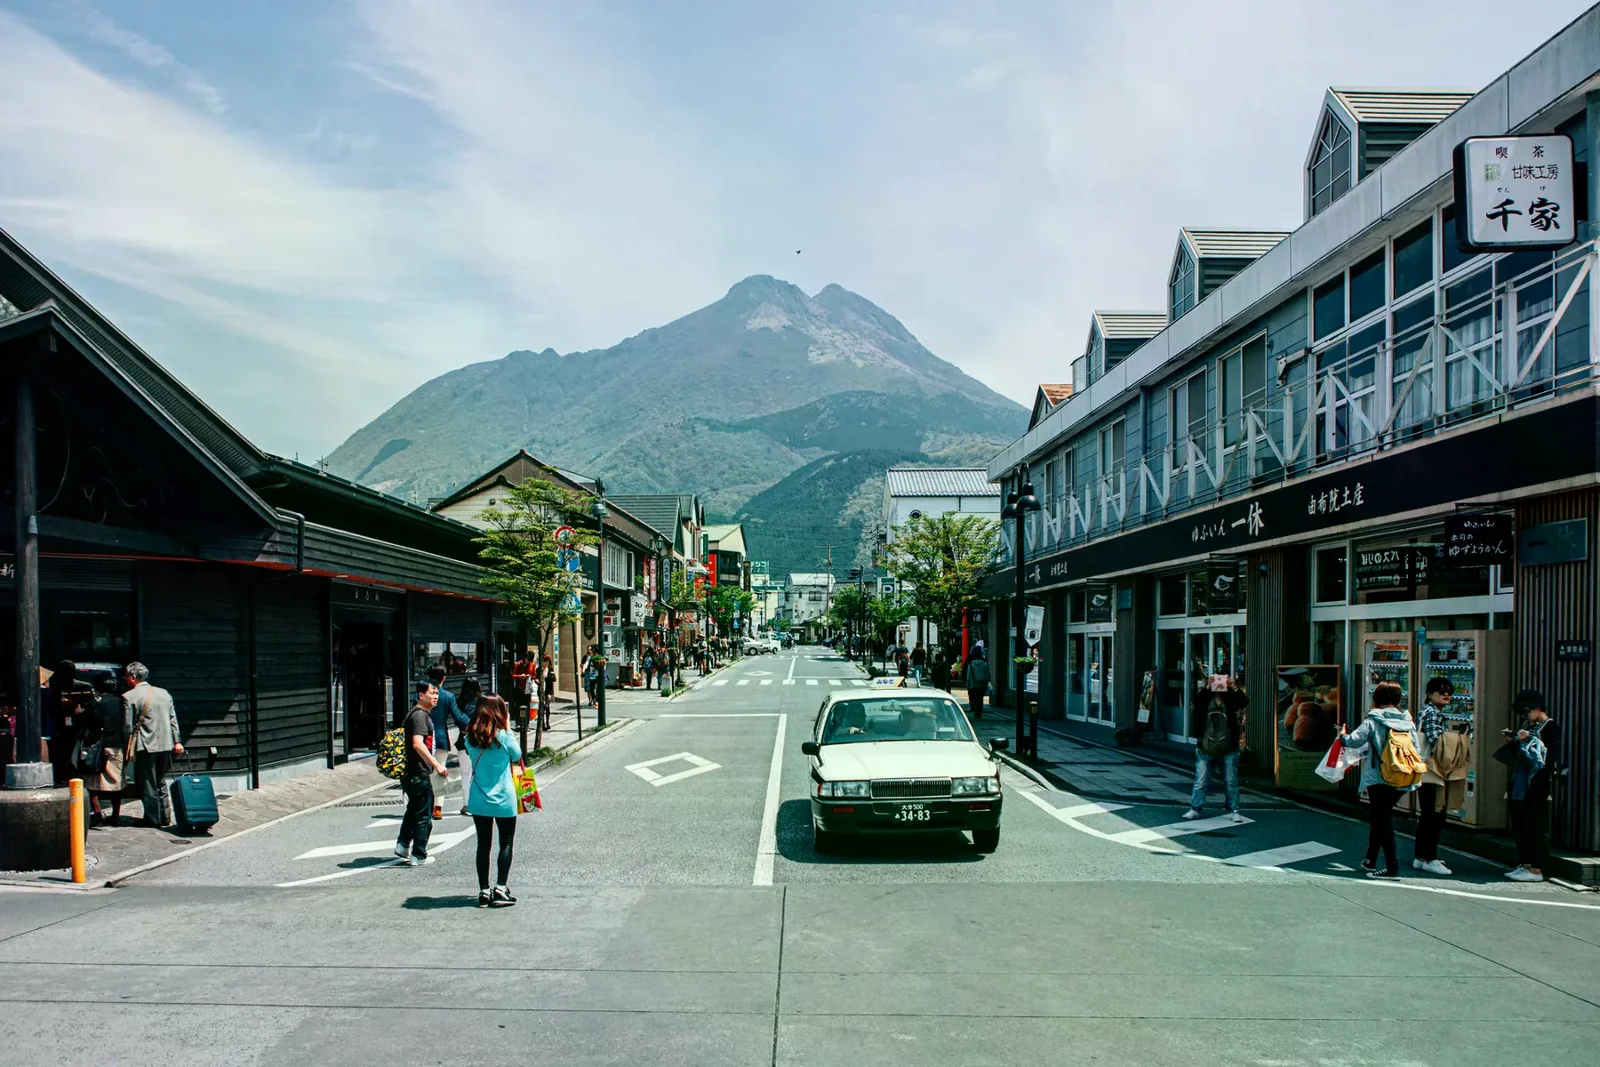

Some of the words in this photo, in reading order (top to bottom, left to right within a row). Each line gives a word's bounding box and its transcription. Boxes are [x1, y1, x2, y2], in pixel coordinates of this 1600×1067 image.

[1511, 164, 1559, 180] 甘味工房
[1485, 197, 1561, 232] 千家
[1308, 482, 1364, 515] 由布院土産
[1192, 519, 1227, 542] ゆふいん
[1231, 501, 1265, 536] 一休
[1448, 540, 1508, 557] ゆずようかん
